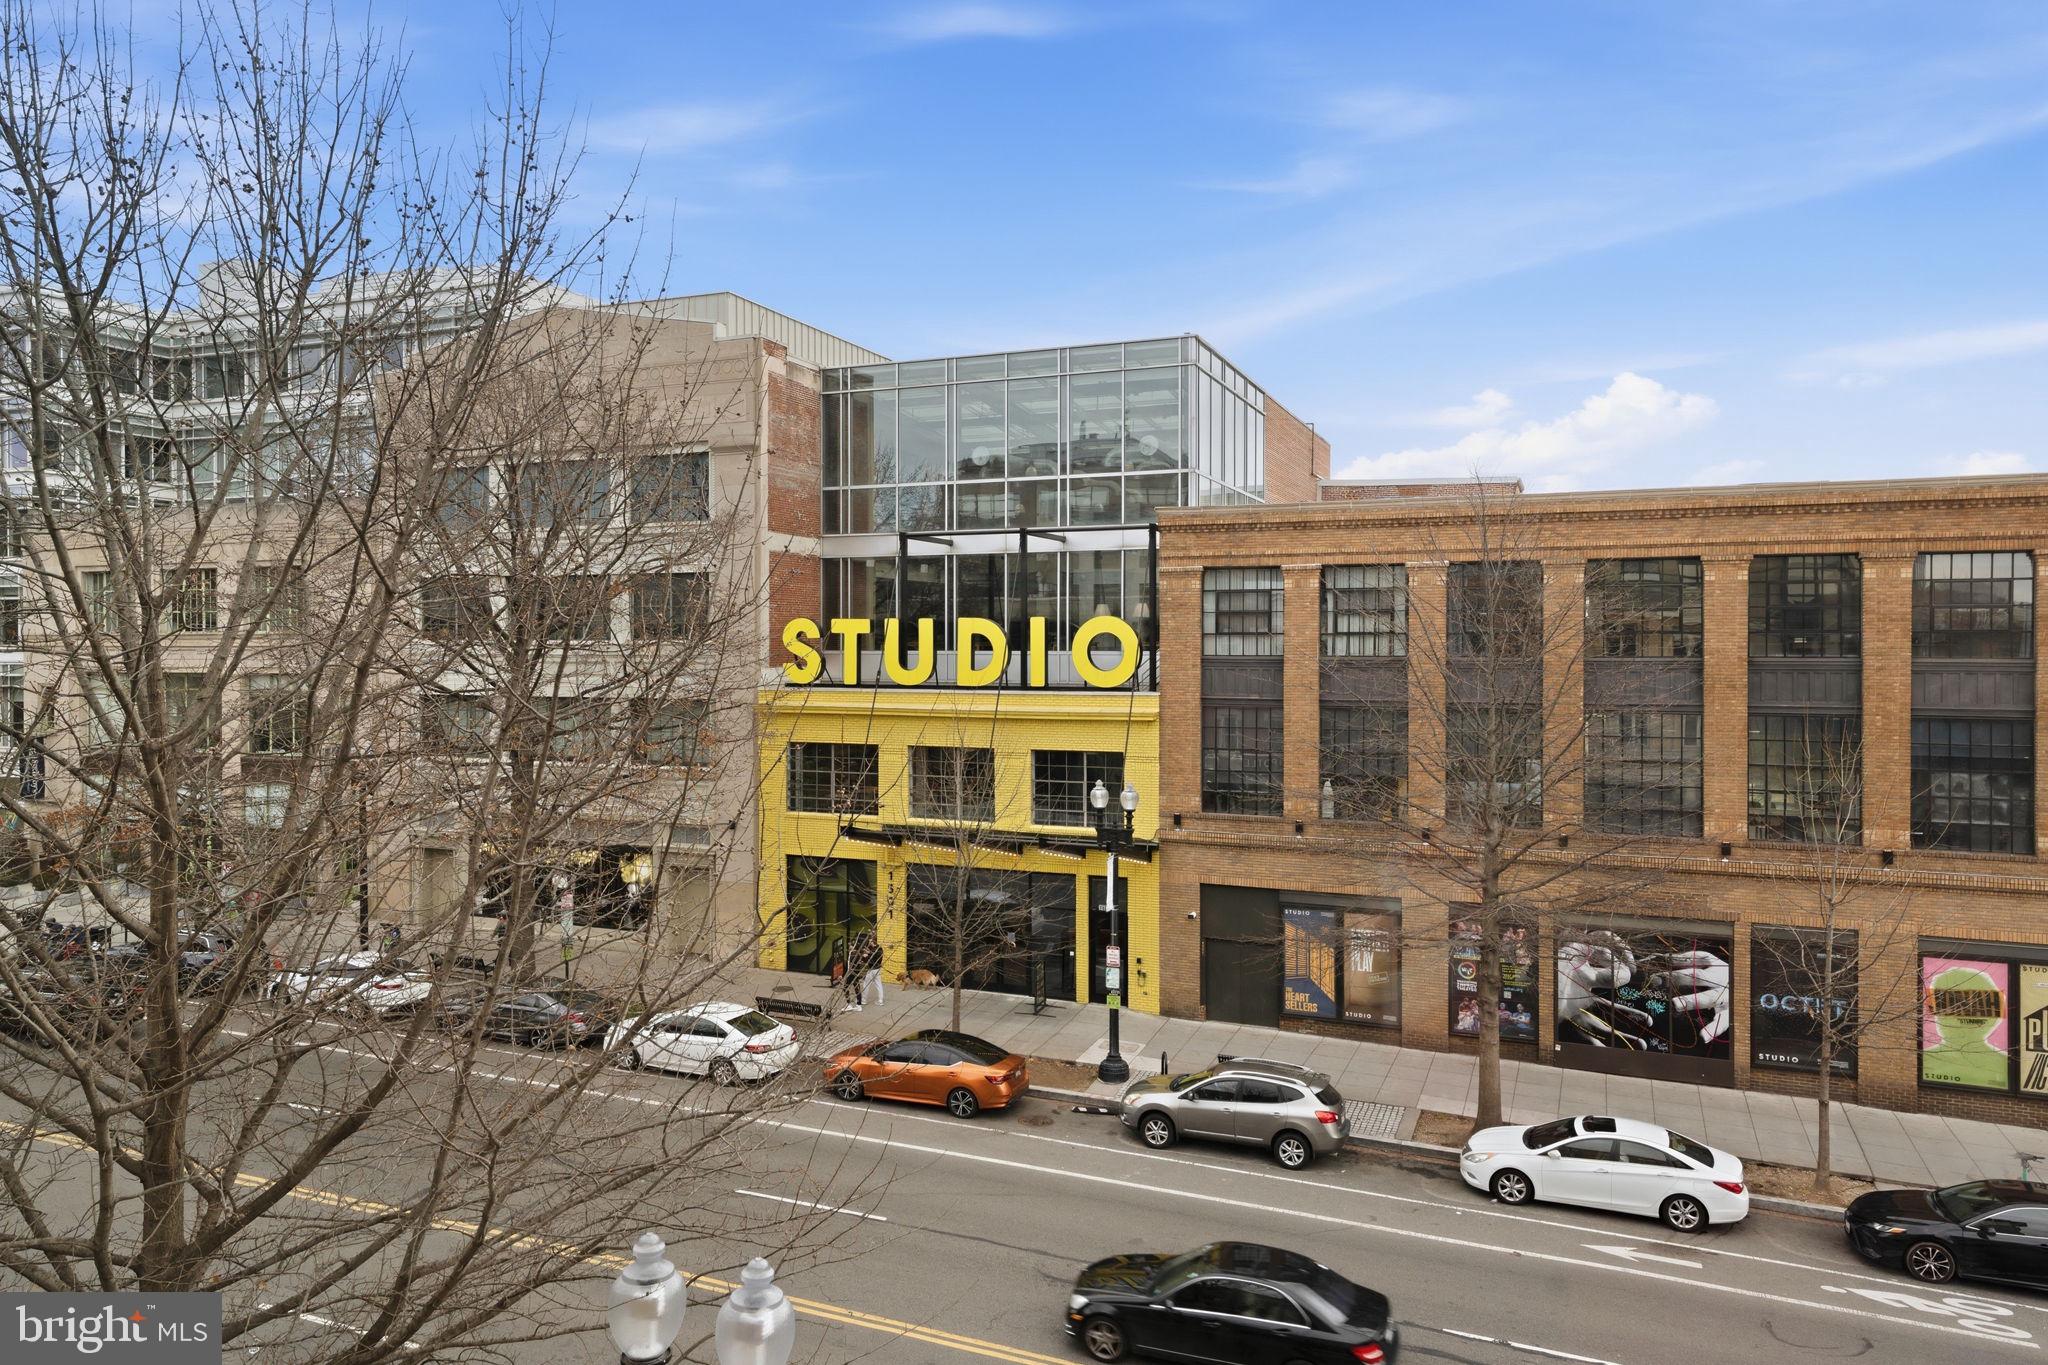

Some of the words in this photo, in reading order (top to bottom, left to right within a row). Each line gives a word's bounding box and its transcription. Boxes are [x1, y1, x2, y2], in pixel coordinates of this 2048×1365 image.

[782, 615, 1142, 687] STUDIO
[1285, 991, 1311, 1003] HEART
[1285, 1000, 1318, 1013] SELLERS
[1344, 1011, 1372, 1019] STUDIO
[1758, 1053, 1799, 1063] STUDIO
[1925, 1072, 1961, 1082] STUDIO
